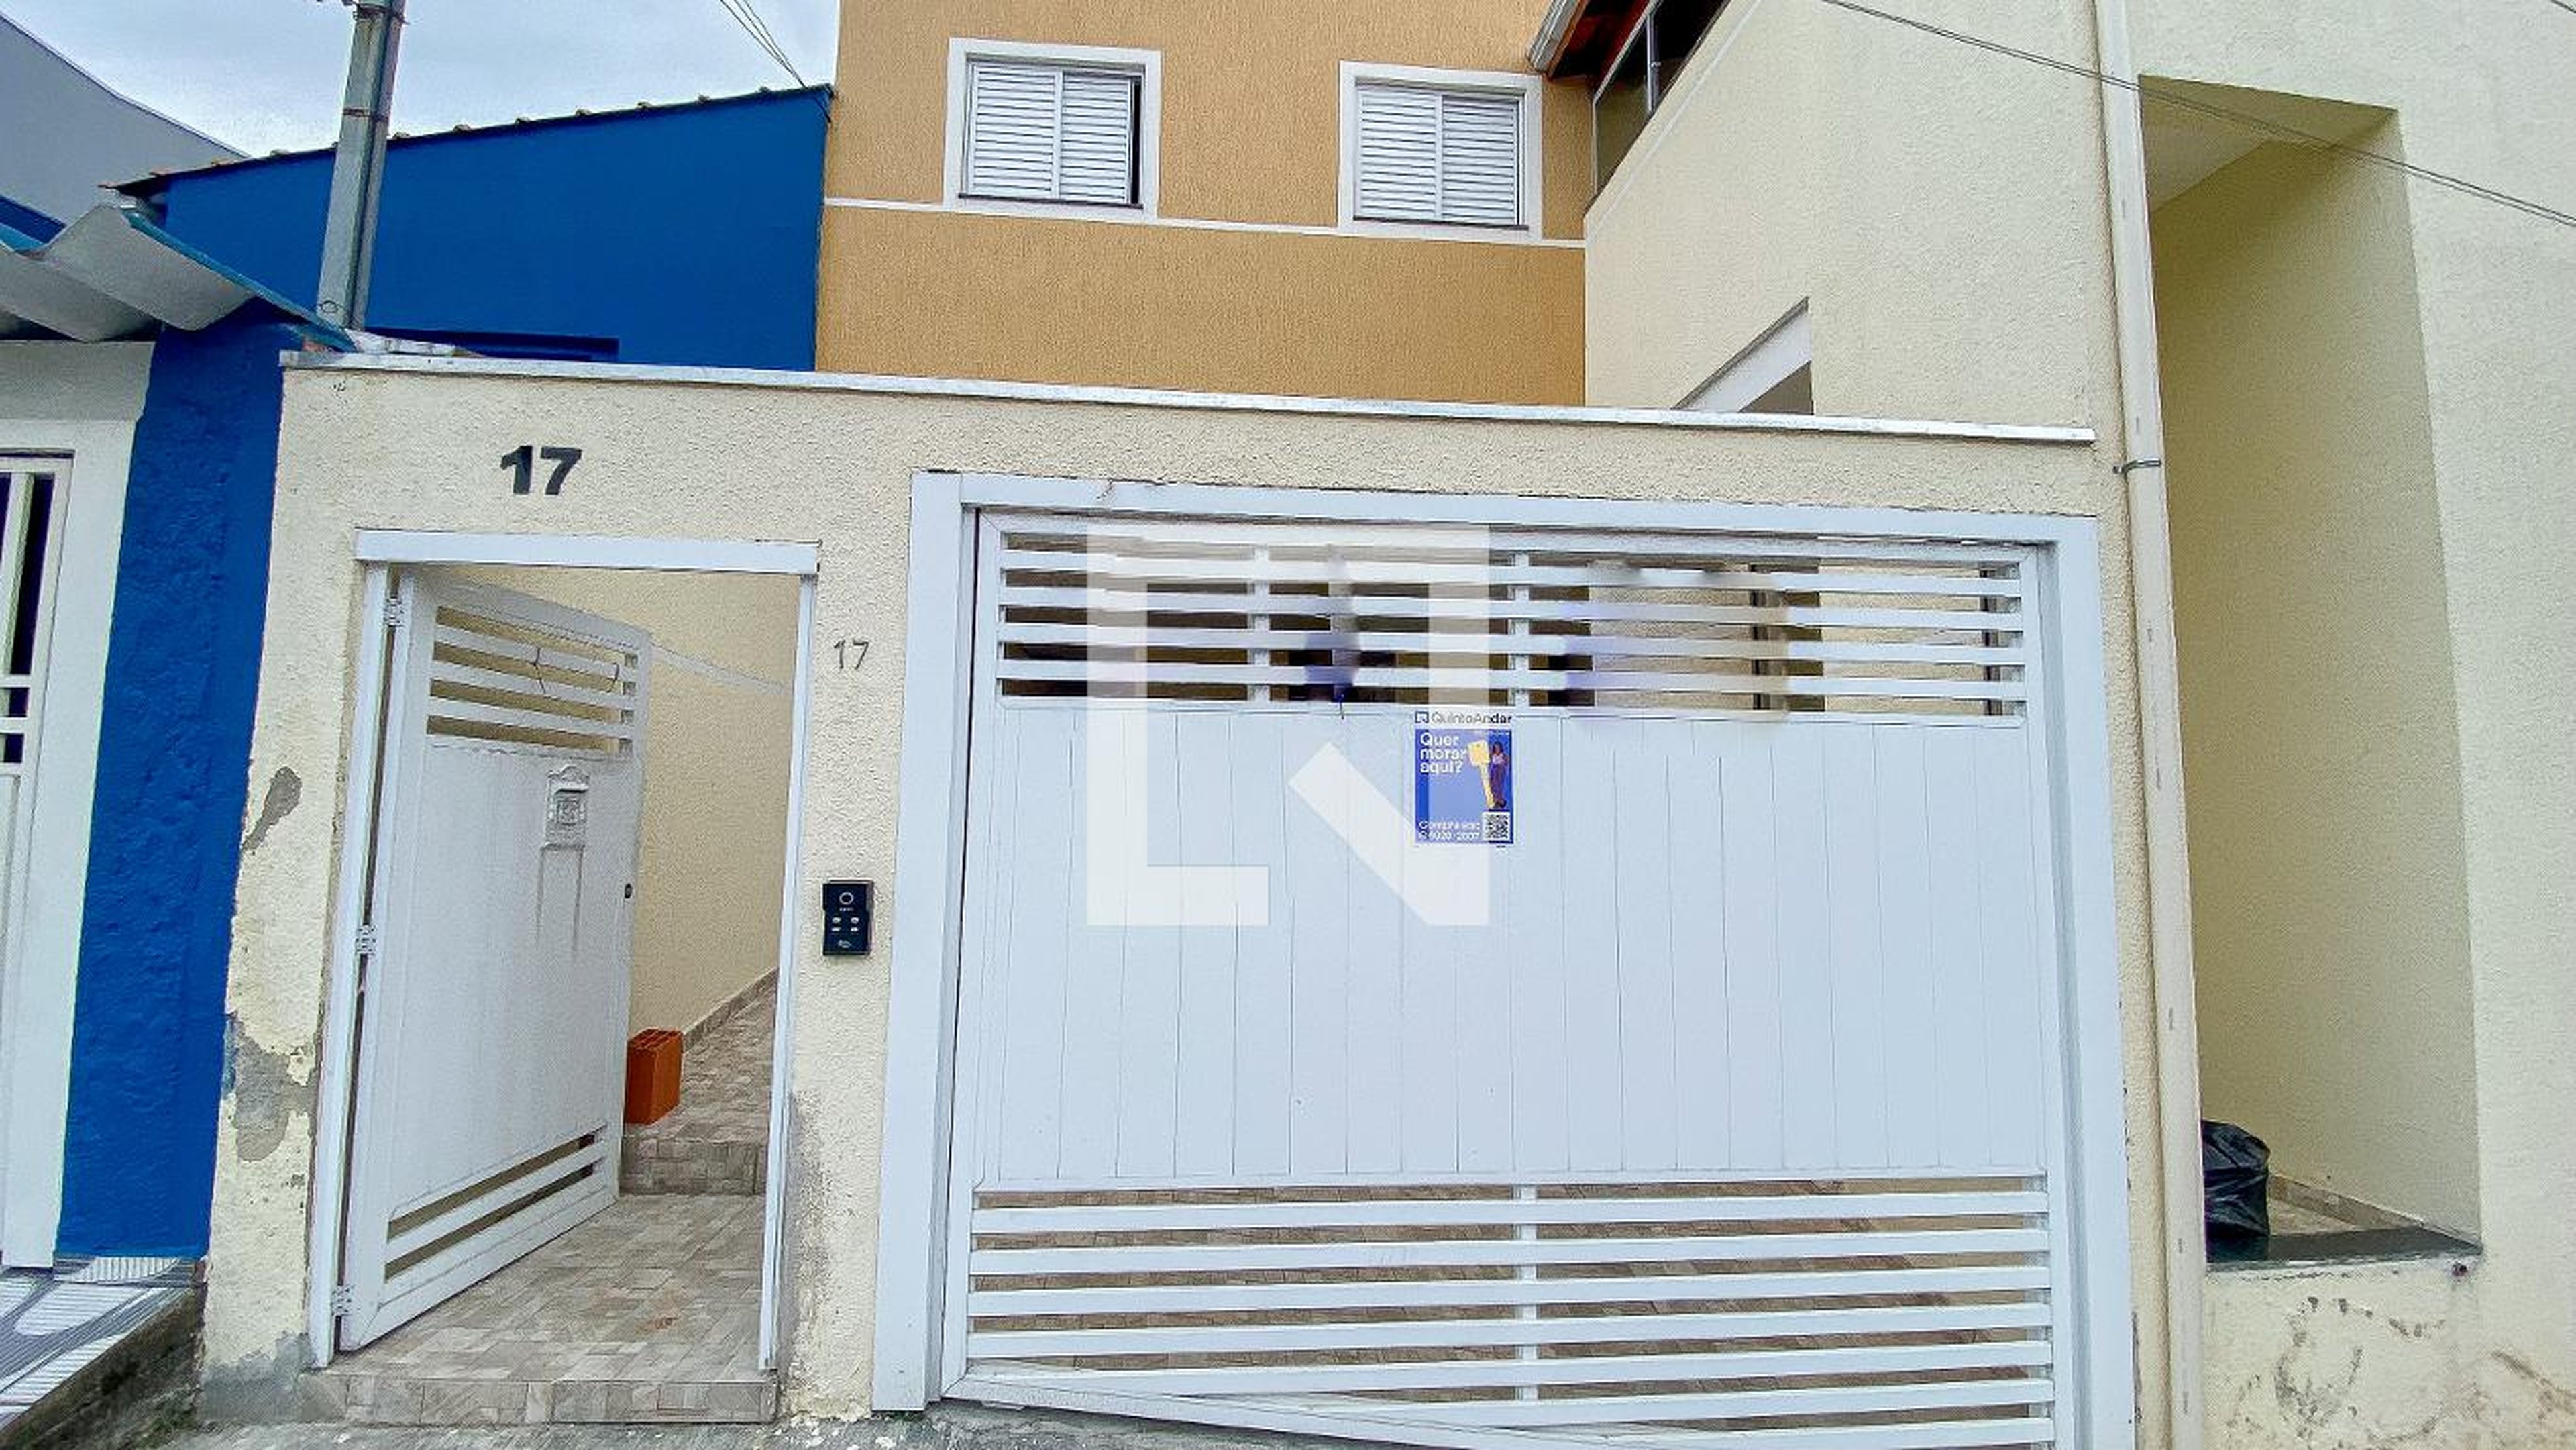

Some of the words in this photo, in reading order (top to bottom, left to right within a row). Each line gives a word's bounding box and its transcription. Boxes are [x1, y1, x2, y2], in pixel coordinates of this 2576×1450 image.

[500, 445, 582, 495] 17
[834, 639, 869, 670] 17
[1431, 713, 1512, 724] QuintoAndar
[1420, 733, 1460, 747] Quer
[1420, 749, 1467, 760] morar
[1420, 761, 1463, 775] aqui?
